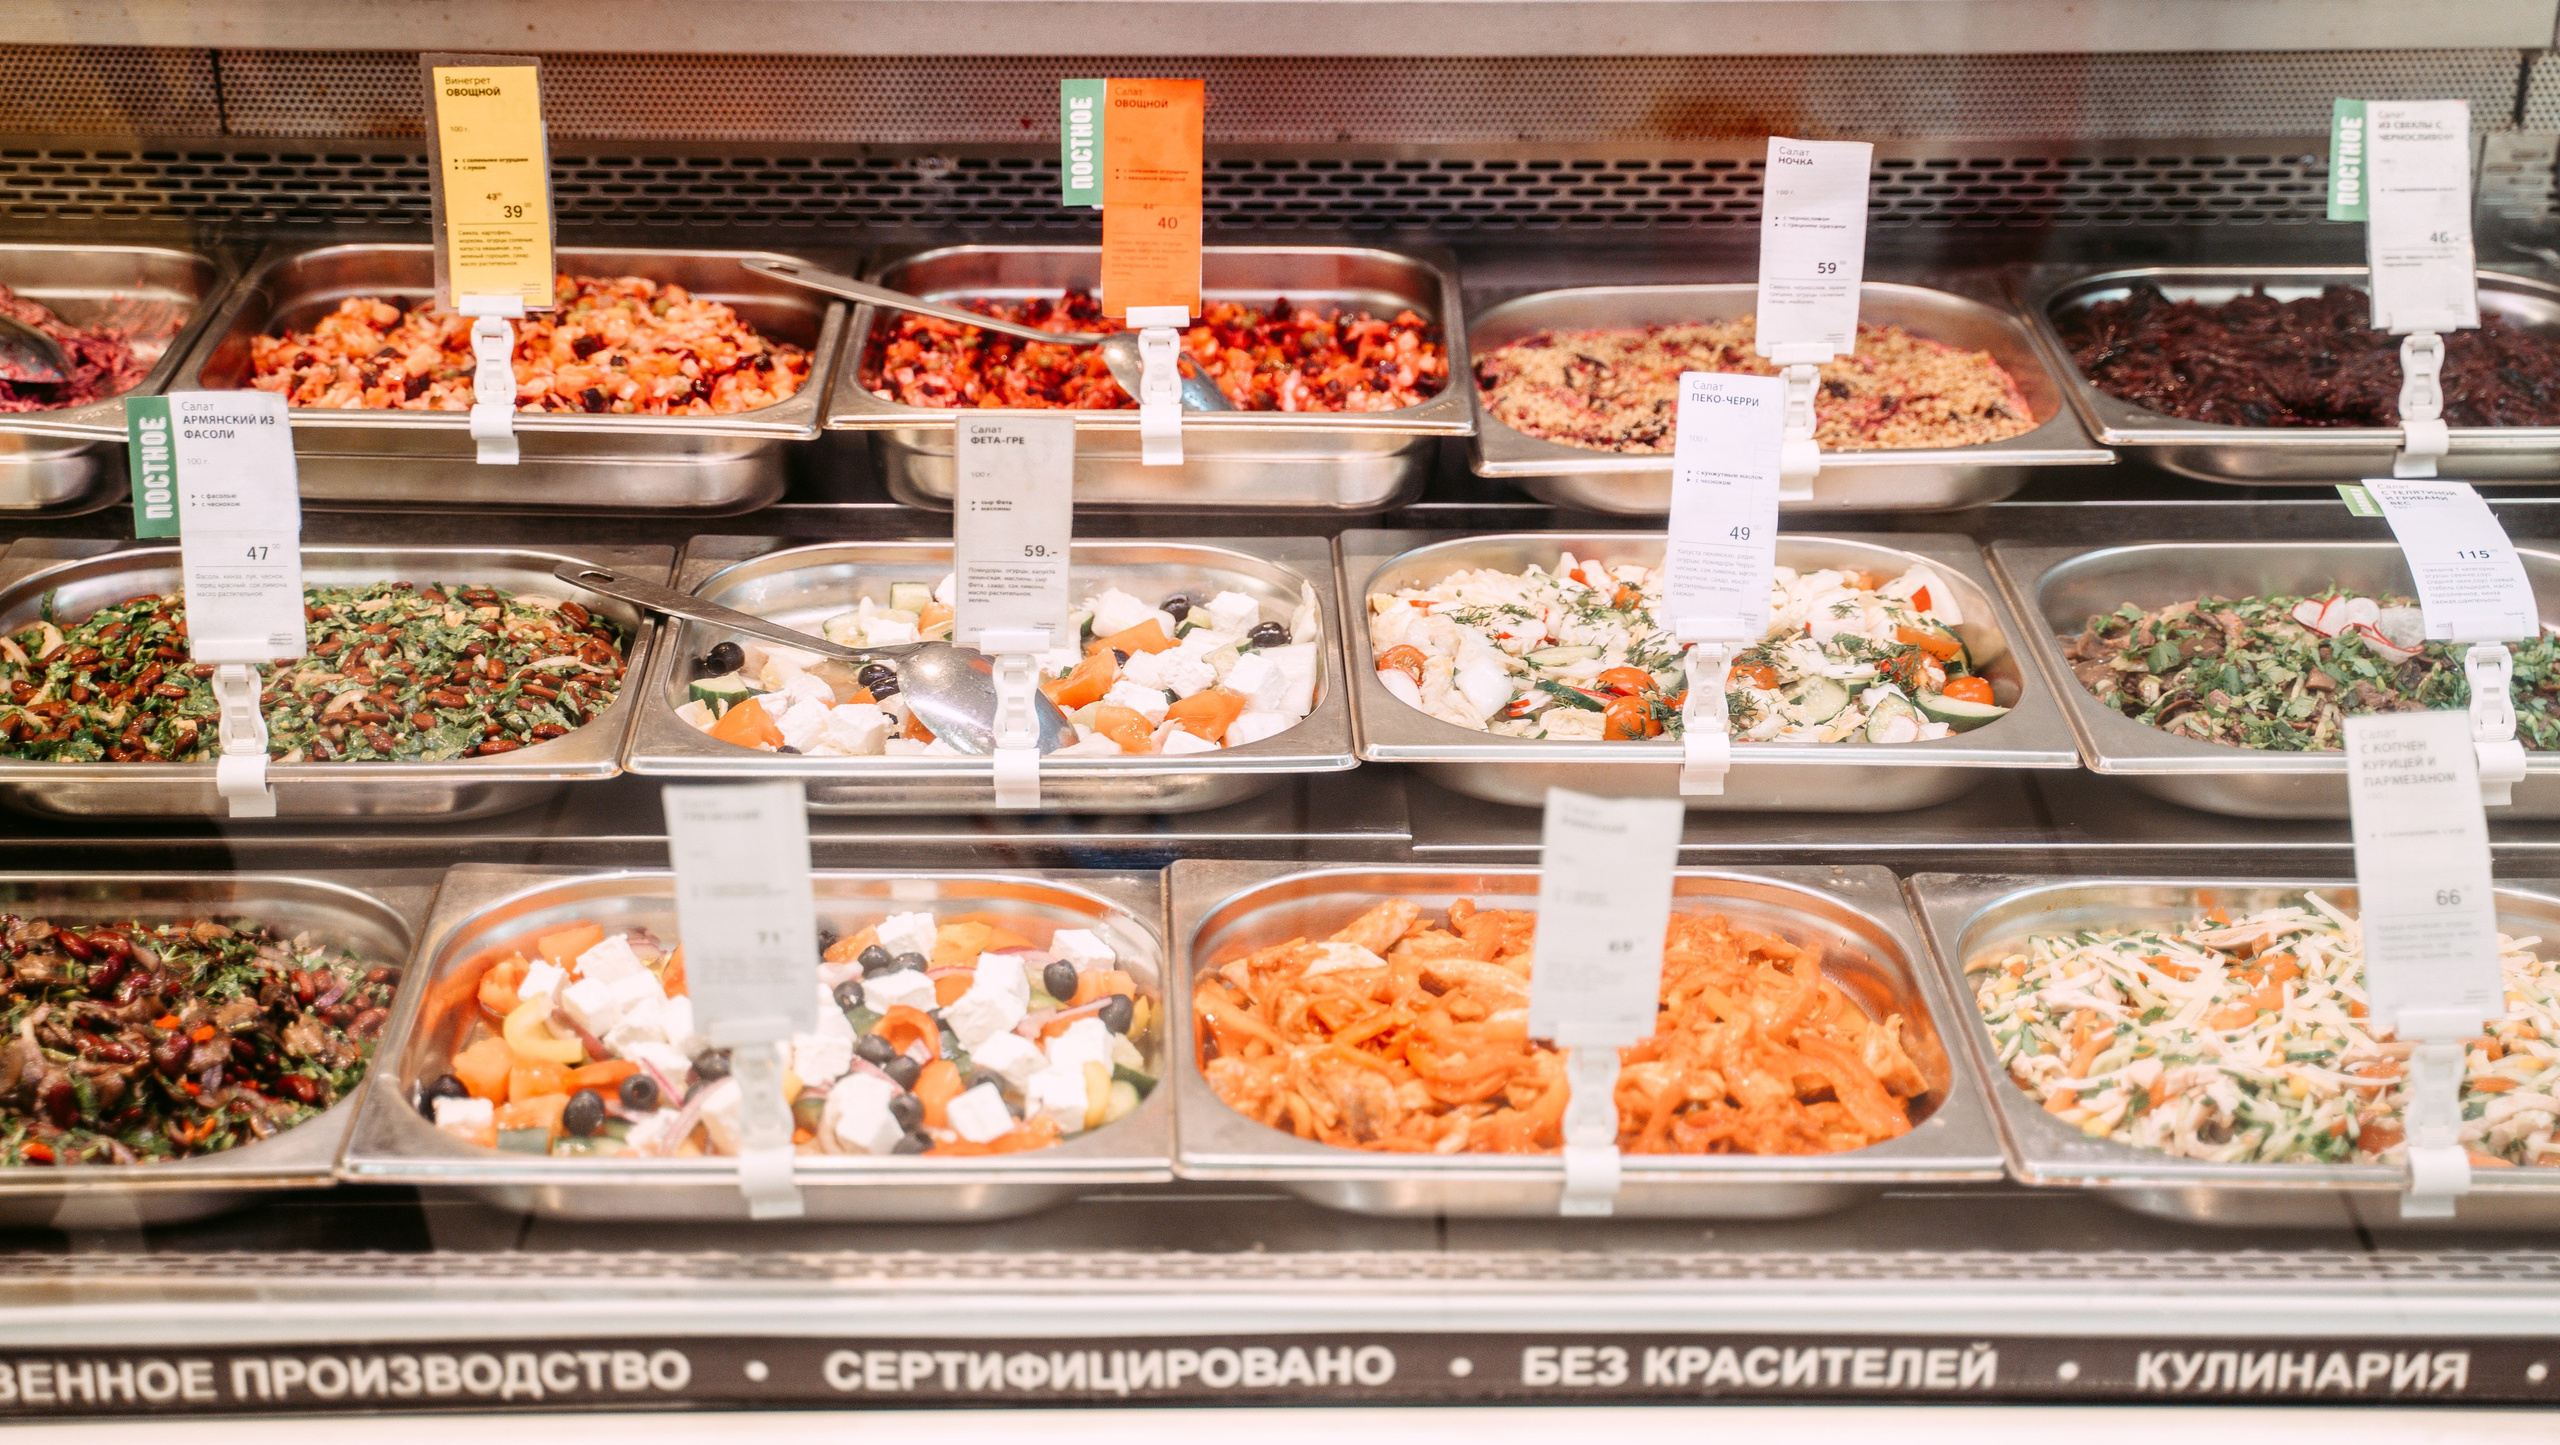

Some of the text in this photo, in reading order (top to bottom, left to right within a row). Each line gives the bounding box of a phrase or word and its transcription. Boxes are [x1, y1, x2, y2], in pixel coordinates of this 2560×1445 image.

[445, 76, 491, 86] Винегрет
[446, 87, 501, 97] ОВОЩНОЙ
[1115, 87, 1143, 96] Салат
[1115, 99, 1168, 109] ОВОЩНОЙ
[1070, 97, 1094, 189] ПОСТНОЕ
[1779, 146, 1810, 156] Салат
[1778, 157, 1814, 165] НОЧКА
[2336, 116, 2363, 206] ПОСТНОЕ
[503, 205, 523, 218] 39
[1158, 217, 1178, 229] 40
[1818, 262, 1837, 274] 59
[1692, 380, 1724, 391] Салат
[1691, 392, 1759, 407] ПЕКО-ЧЕРРИ
[181, 402, 215, 412] Салат
[183, 413, 275, 426] АРМЯНСКИЙ ИЗ
[184, 429, 235, 439] ФАСОЛИ
[970, 425, 1002, 434] Салат
[970, 436, 1025, 445] ФЕТА-ГРЕ
[139, 416, 173, 520] ПОСТНОЕ
[1729, 526, 1751, 541] 49
[246, 546, 269, 561] 47
[1024, 545, 1058, 558] 59.-
[2457, 550, 2490, 559] 115
[2361, 740, 2427, 754] С КОПЧЕН
[2362, 756, 2437, 771] КУРИЦЕЙ И
[2364, 772, 2457, 788] ПАРМЕЗАНОМ
[2436, 889, 2461, 906] 66
[230, 1350, 692, 1402] ПРОИЗВОДСТВО
[822, 1343, 1398, 1397] СЕРТИФИЦИРОВАНО
[1520, 1345, 1630, 1388] БЕЗ
[1641, 1340, 1998, 1390] КРАСИТЕЛЕЙ
[2134, 1350, 2470, 1391] КУЛИНАРИЯ
